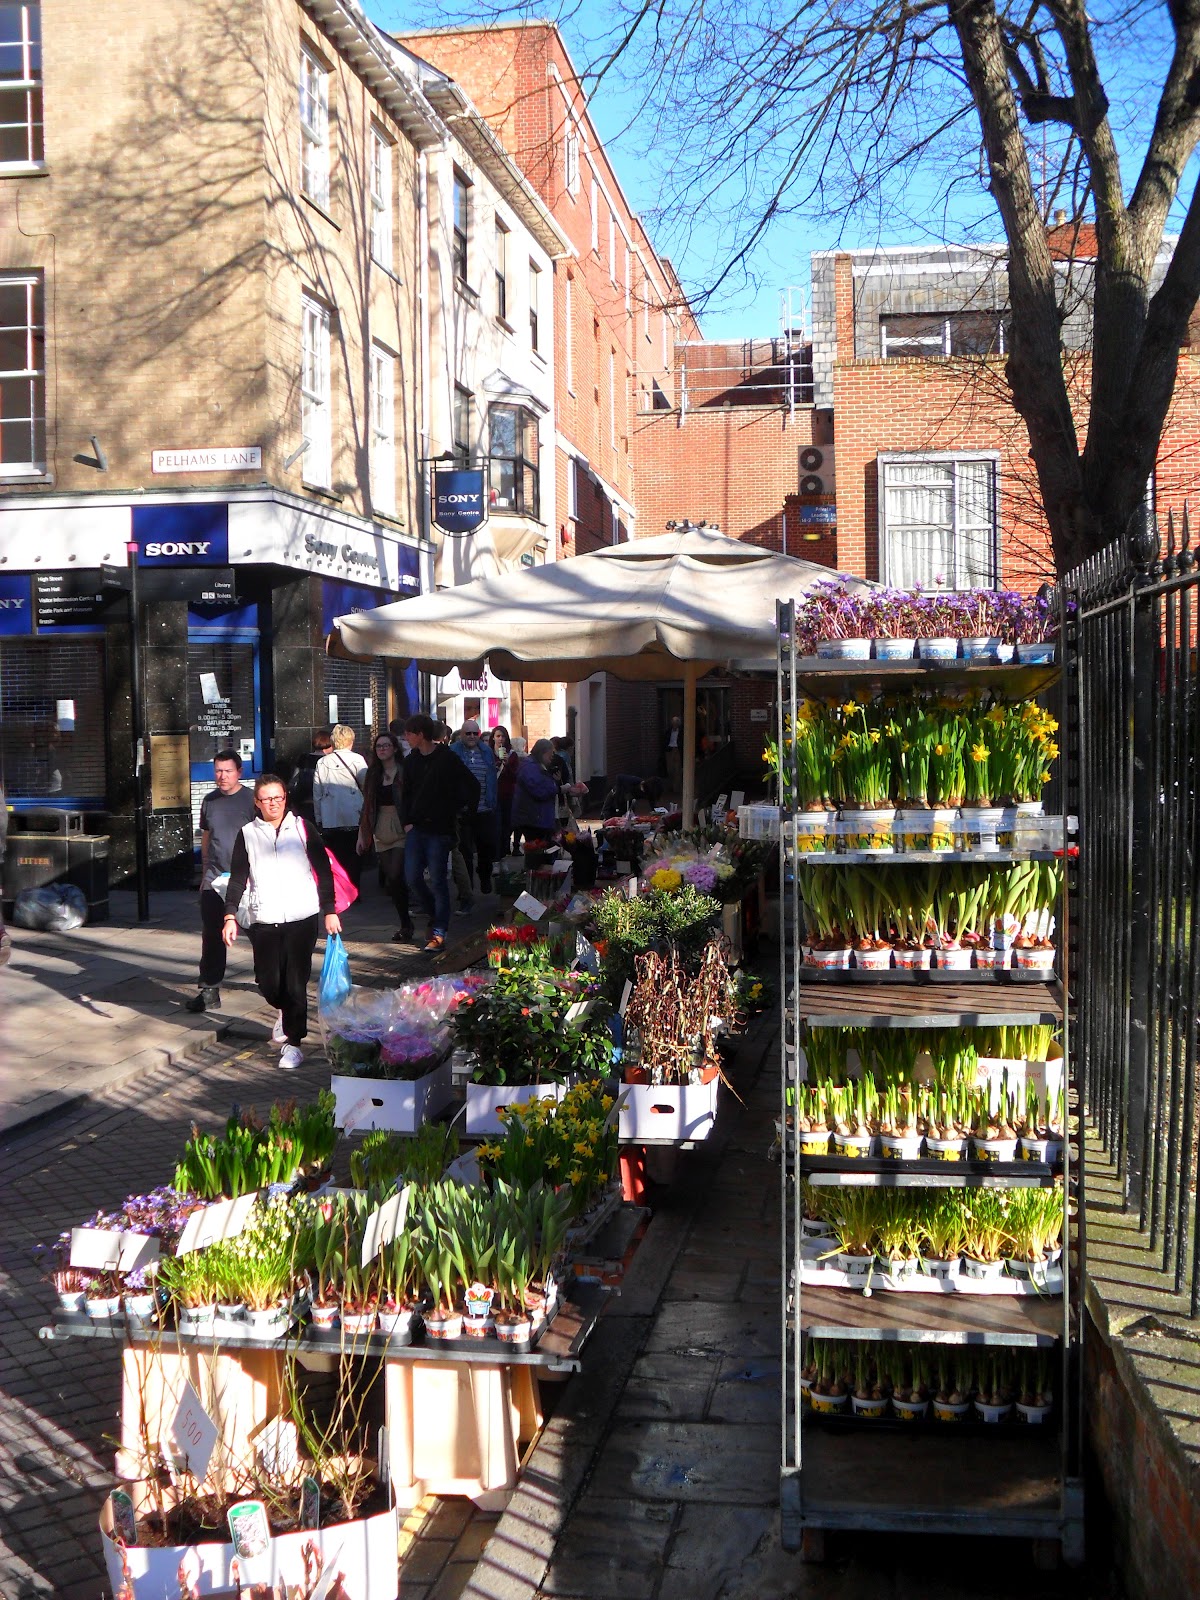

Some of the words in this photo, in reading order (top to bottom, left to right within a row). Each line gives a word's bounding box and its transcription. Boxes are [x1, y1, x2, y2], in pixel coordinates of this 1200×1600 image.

[158, 454, 217, 466] PELHAMS
[223, 452, 256, 464] LANE
[438, 494, 480, 503] SONY
[145, 541, 211, 556] SONY
[305, 533, 338, 562] Sony
[341, 544, 379, 570] Centre
[20, 857, 49, 865] LITTER
